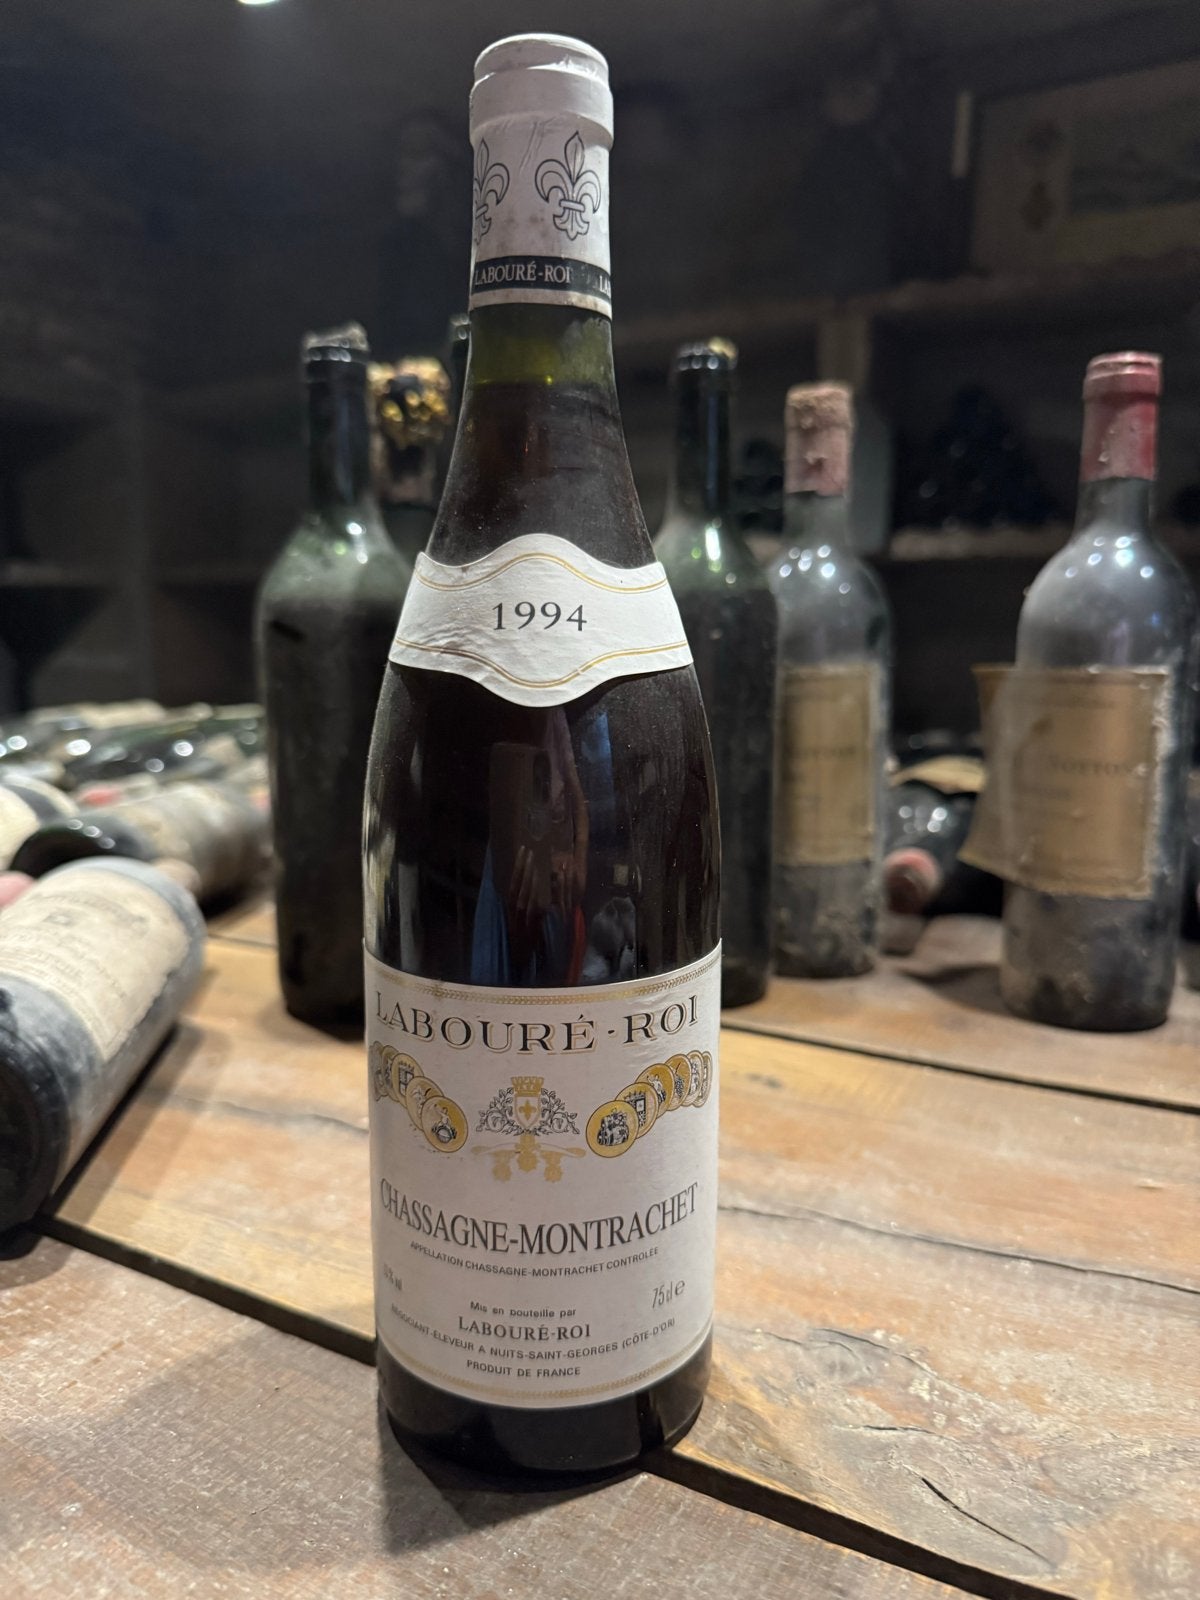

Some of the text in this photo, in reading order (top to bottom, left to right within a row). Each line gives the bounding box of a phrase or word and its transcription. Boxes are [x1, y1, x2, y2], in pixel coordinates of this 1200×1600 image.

[492, 601, 587, 632] 1994
[380, 1177, 698, 1255] CHASSAGNE-MONTRACHET
[410, 1240, 463, 1268] APPELLATION
[464, 1260, 605, 1277] CHASSAGNE-MONTRACHET
[470, 1301, 576, 1320] Mis en bouteille par
[458, 1316, 591, 1342] LABOURÉ-ROI
[490, 1341, 619, 1361] NUITS-SAINT-GEORGES
[466, 1359, 582, 1378] PRODUIT DE FRANCE
